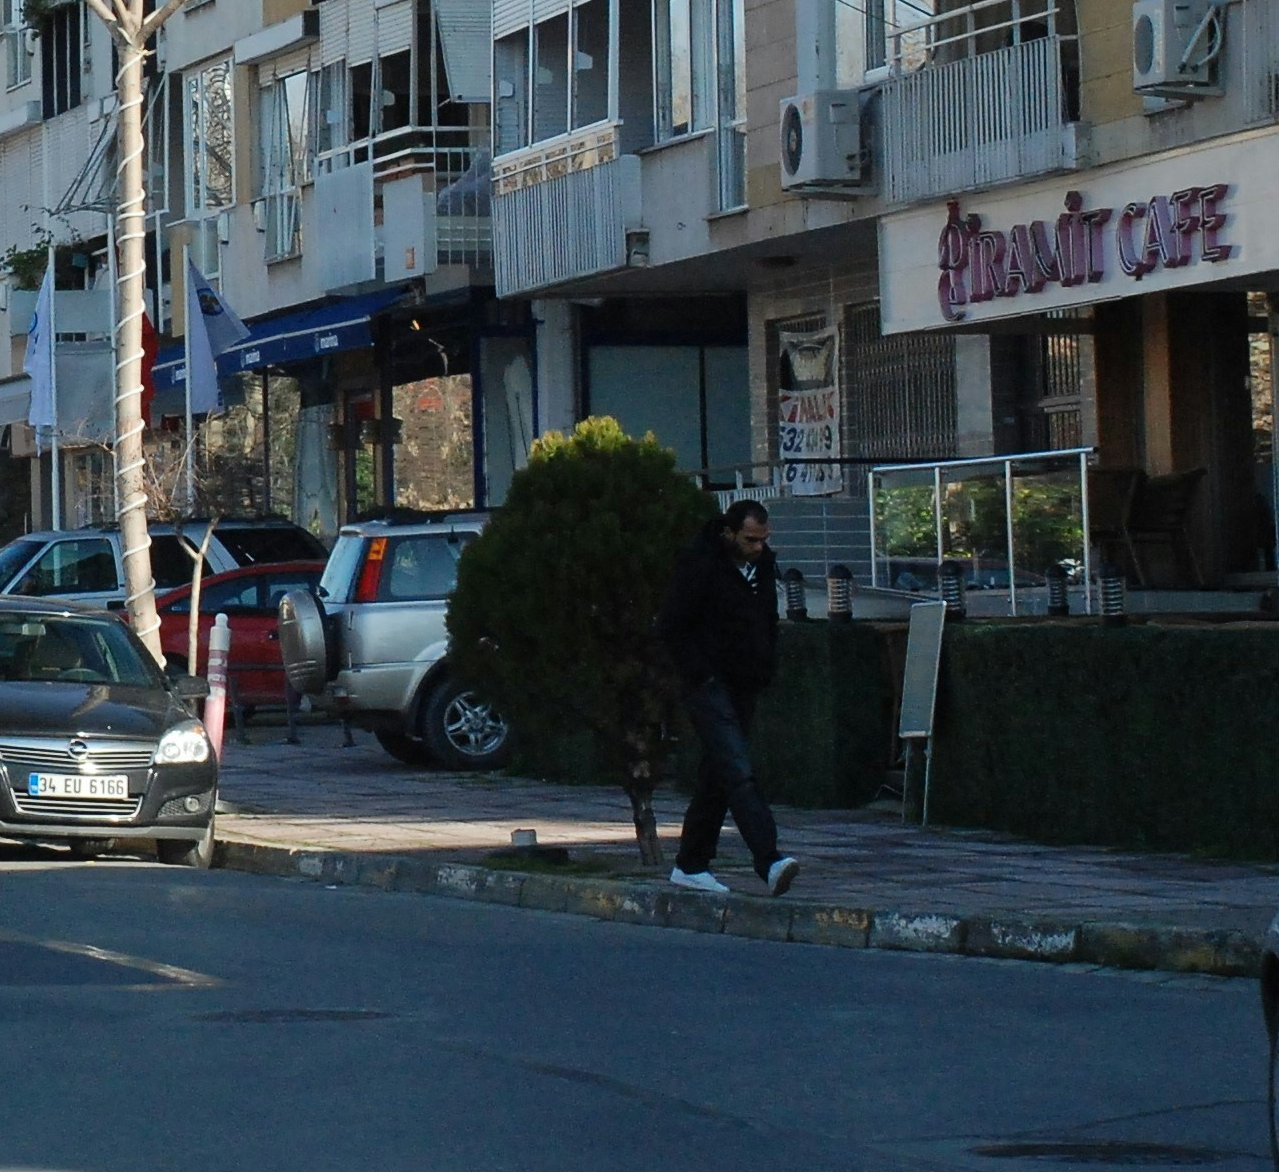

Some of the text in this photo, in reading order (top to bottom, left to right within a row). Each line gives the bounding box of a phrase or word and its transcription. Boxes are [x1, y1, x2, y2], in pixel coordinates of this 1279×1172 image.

[39, 777, 56, 793] 34
[64, 778, 81, 794] EU
[89, 779, 124, 795] 6166
